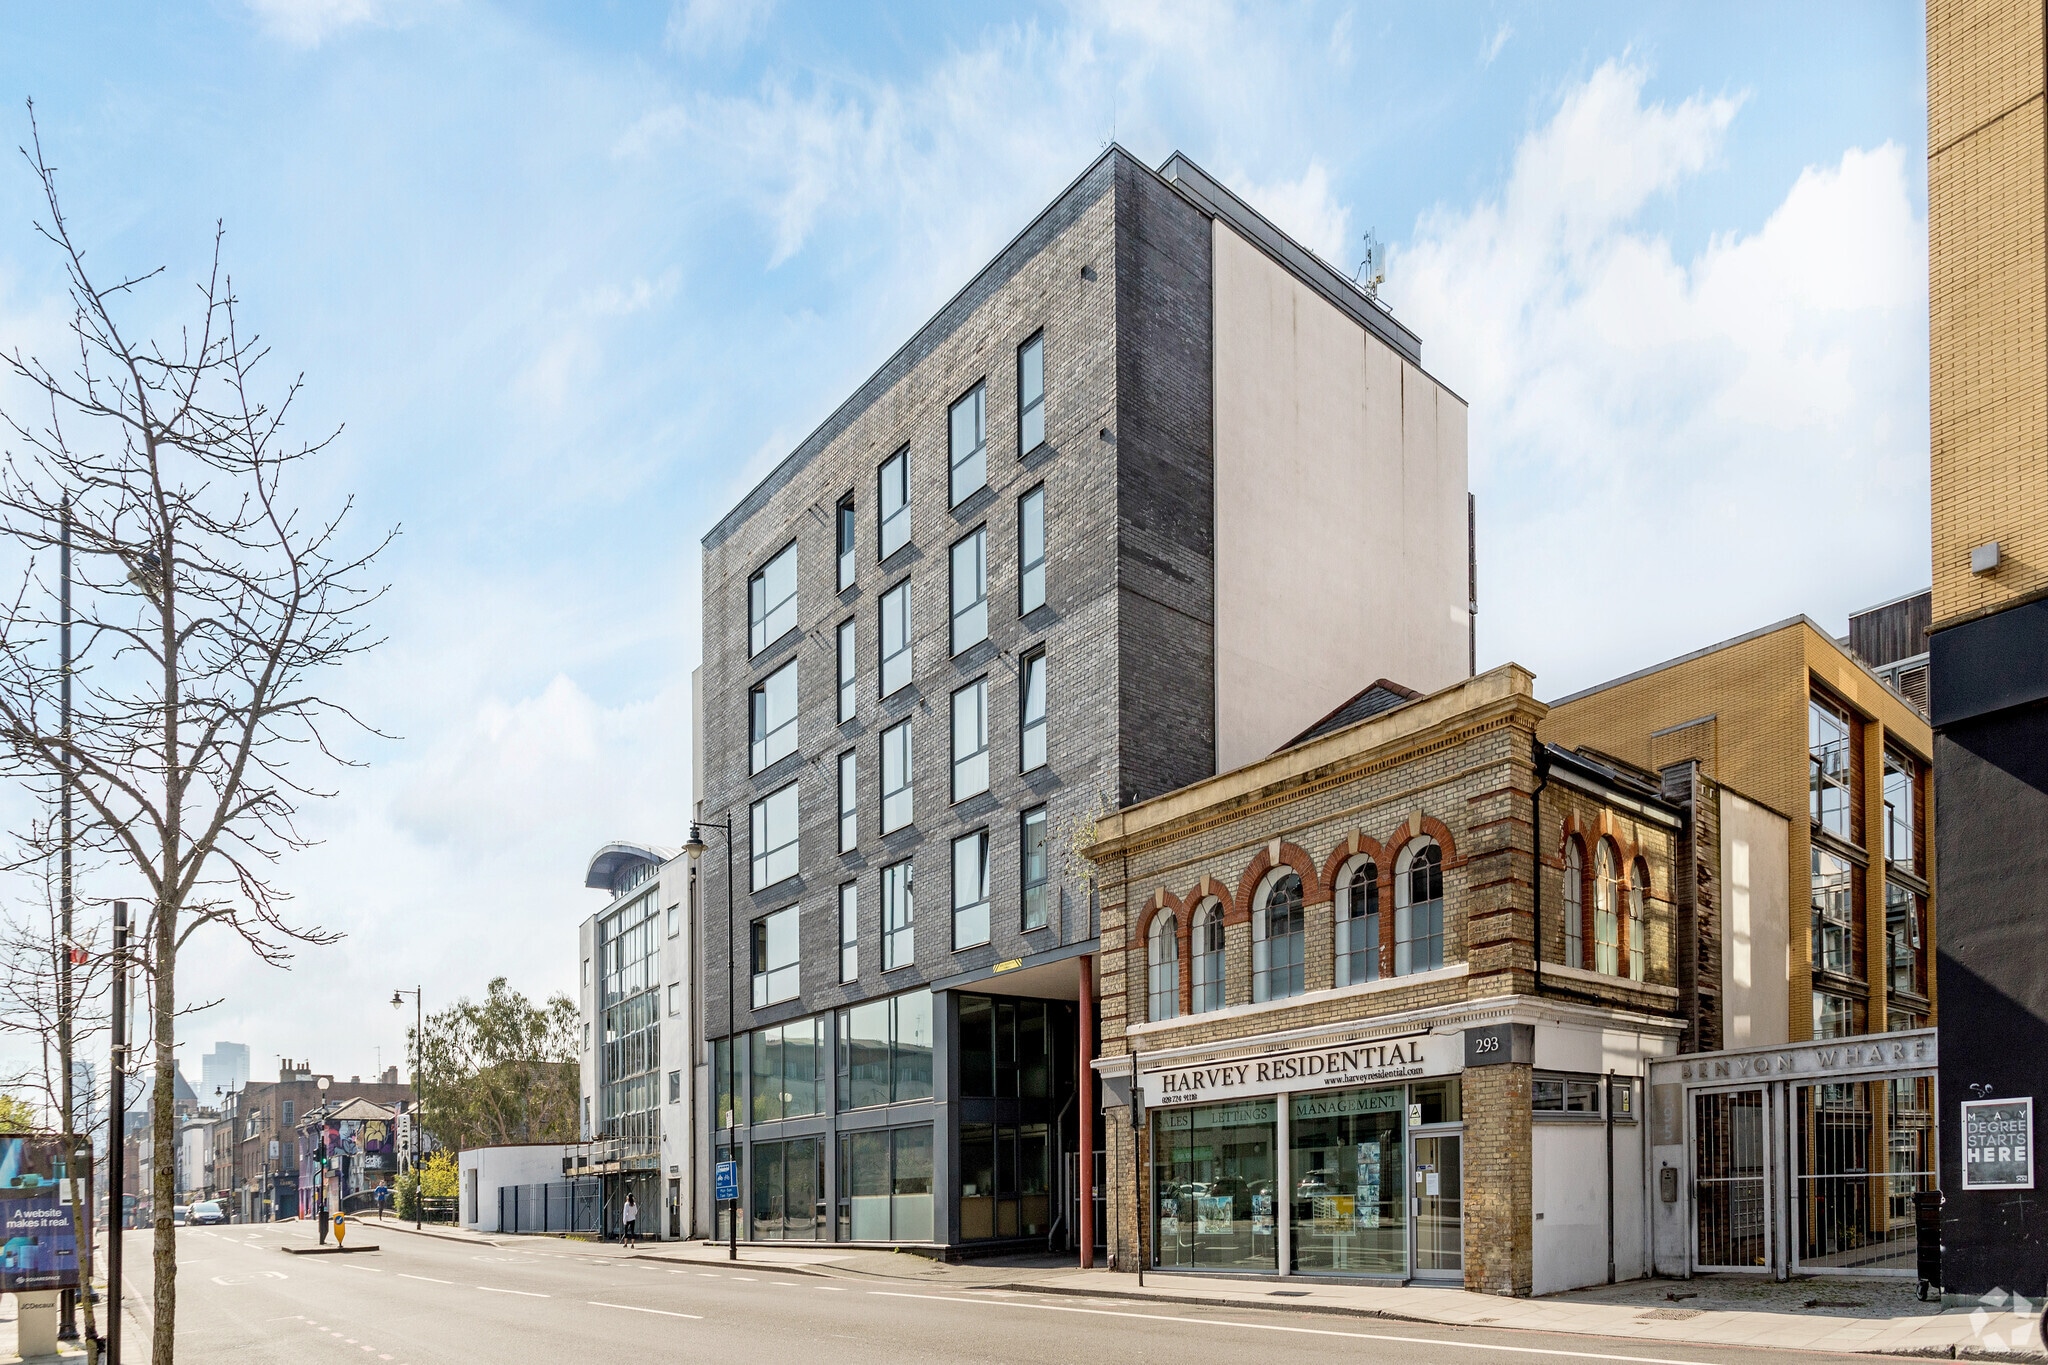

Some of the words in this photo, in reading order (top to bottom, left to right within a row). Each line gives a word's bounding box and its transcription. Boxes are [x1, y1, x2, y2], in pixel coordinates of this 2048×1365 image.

[1475, 1036, 1499, 1053] 293
[1161, 1064, 1250, 1093] HARVEY
[1256, 1041, 1424, 1083] RESIDENTIAL
[1681, 1053, 1794, 1080] BENYON
[1816, 1040, 1925, 1068] WHARF
[1324, 1066, 1424, 1084] www.harveyresidential.com
[1159, 1115, 1188, 1128] SALES
[1211, 1107, 1268, 1124] LETTINGS
[1296, 1095, 1398, 1117] MANAGEMENT
[1968, 1120, 2026, 1134] DEGREE
[1968, 1133, 2026, 1147] STARTS
[1967, 1146, 2026, 1163] HERE
[14, 1210, 23, 1218] A
[24, 1208, 62, 1218] website
[6, 1218, 40, 1228] makes
[40, 1218, 48, 1227] it
[49, 1217, 70, 1227] real.
[20, 1302, 56, 1310] JCDecaux
